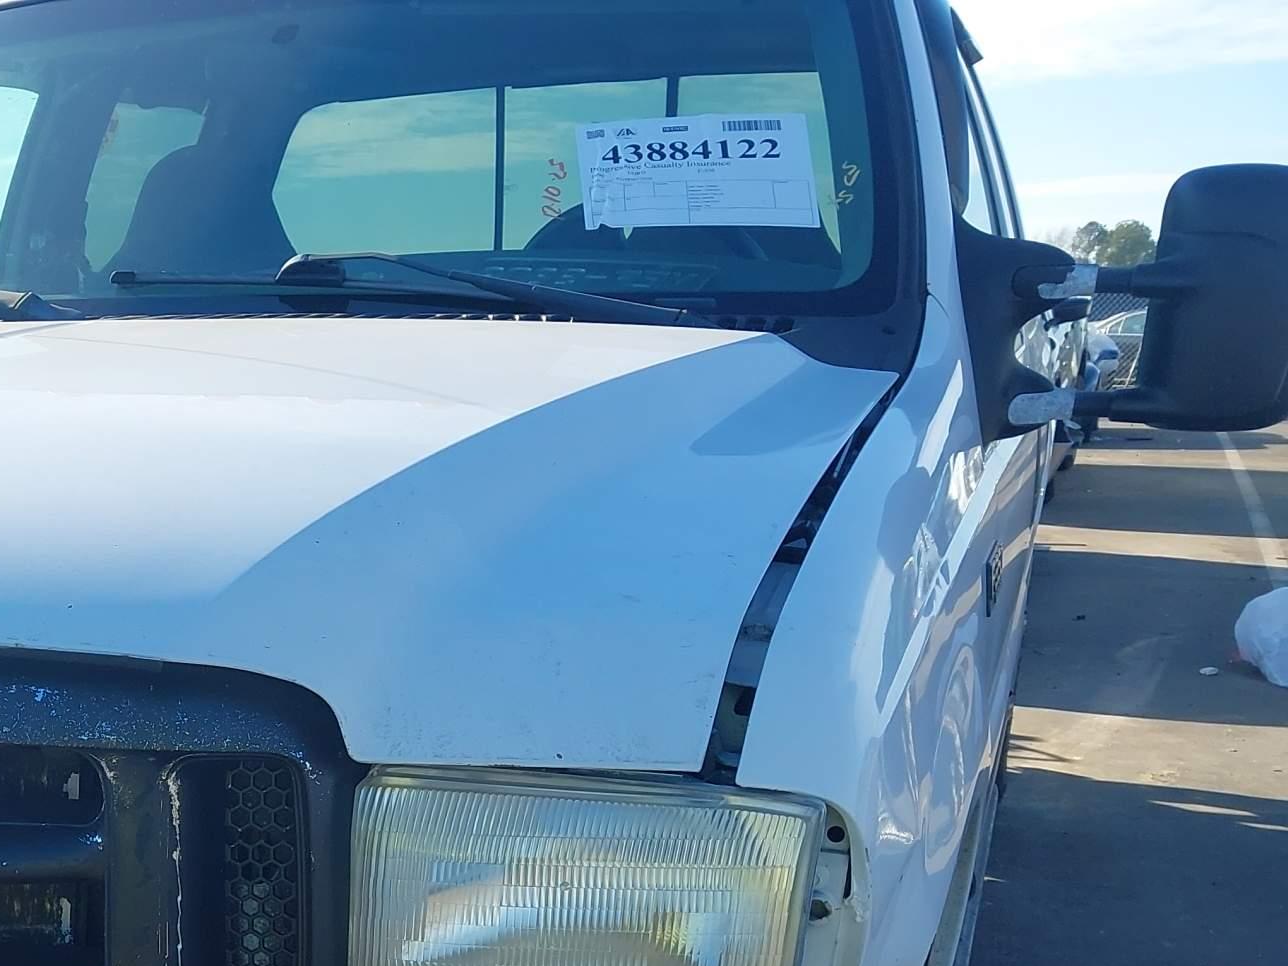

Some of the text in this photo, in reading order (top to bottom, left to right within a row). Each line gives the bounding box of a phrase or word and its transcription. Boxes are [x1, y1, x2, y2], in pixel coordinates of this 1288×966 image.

[601, 138, 781, 164] 43884122
[644, 160, 683, 169] Casualty
[686, 160, 731, 168] Insurance
